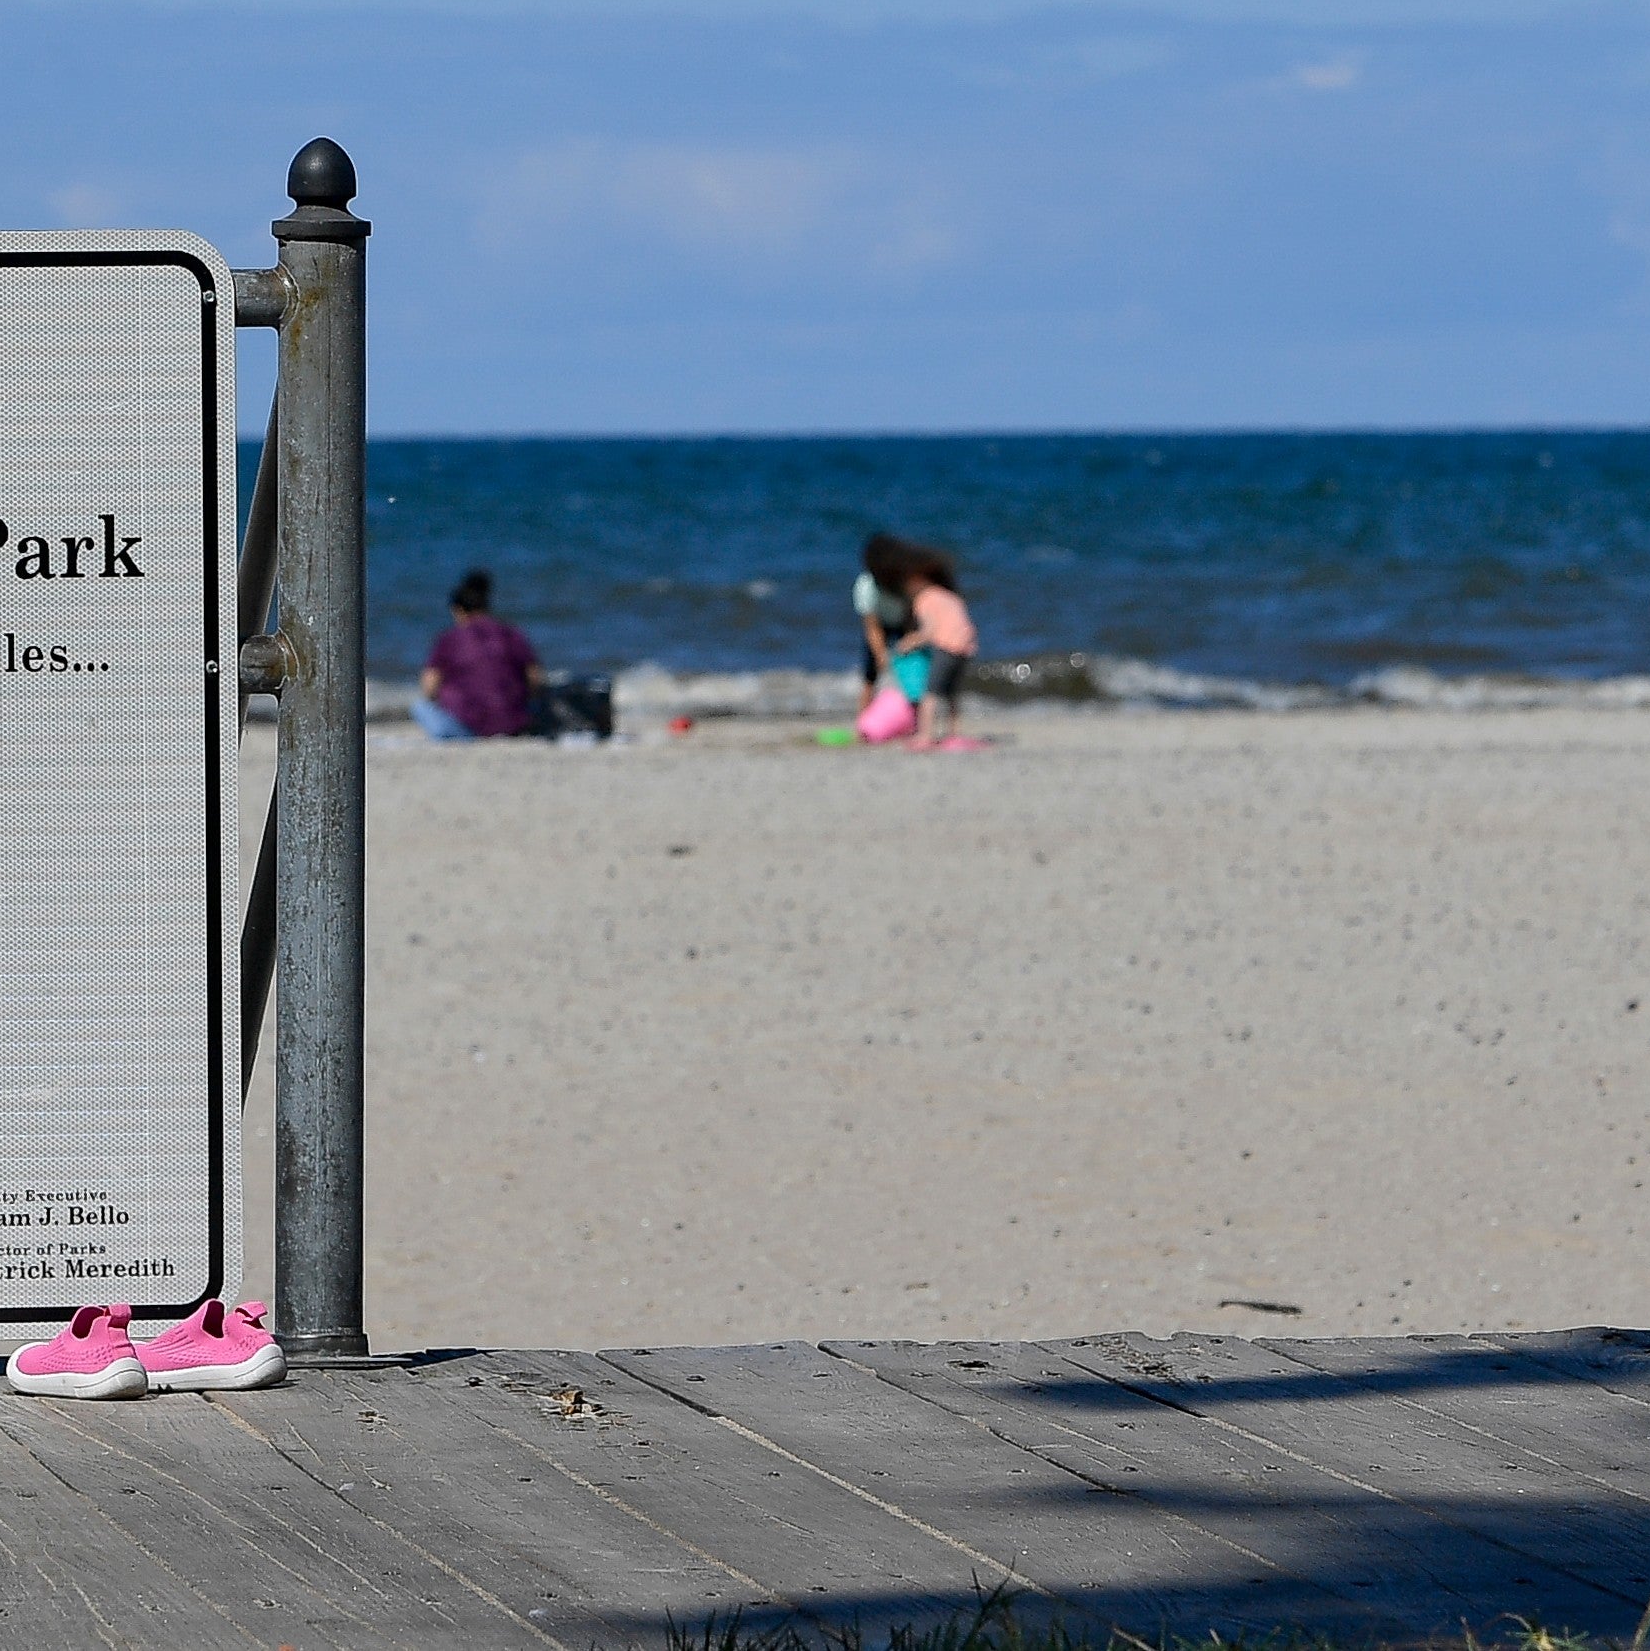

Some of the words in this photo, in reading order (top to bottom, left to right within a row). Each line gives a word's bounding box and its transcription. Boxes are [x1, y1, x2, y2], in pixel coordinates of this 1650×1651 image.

[25, 1189, 107, 1203] Executive
[38, 1206, 59, 1226] J.
[67, 1204, 130, 1226] Bello
[36, 1243, 54, 1256] of
[58, 1242, 106, 1255] Parks
[65, 1258, 175, 1279] Meredith
